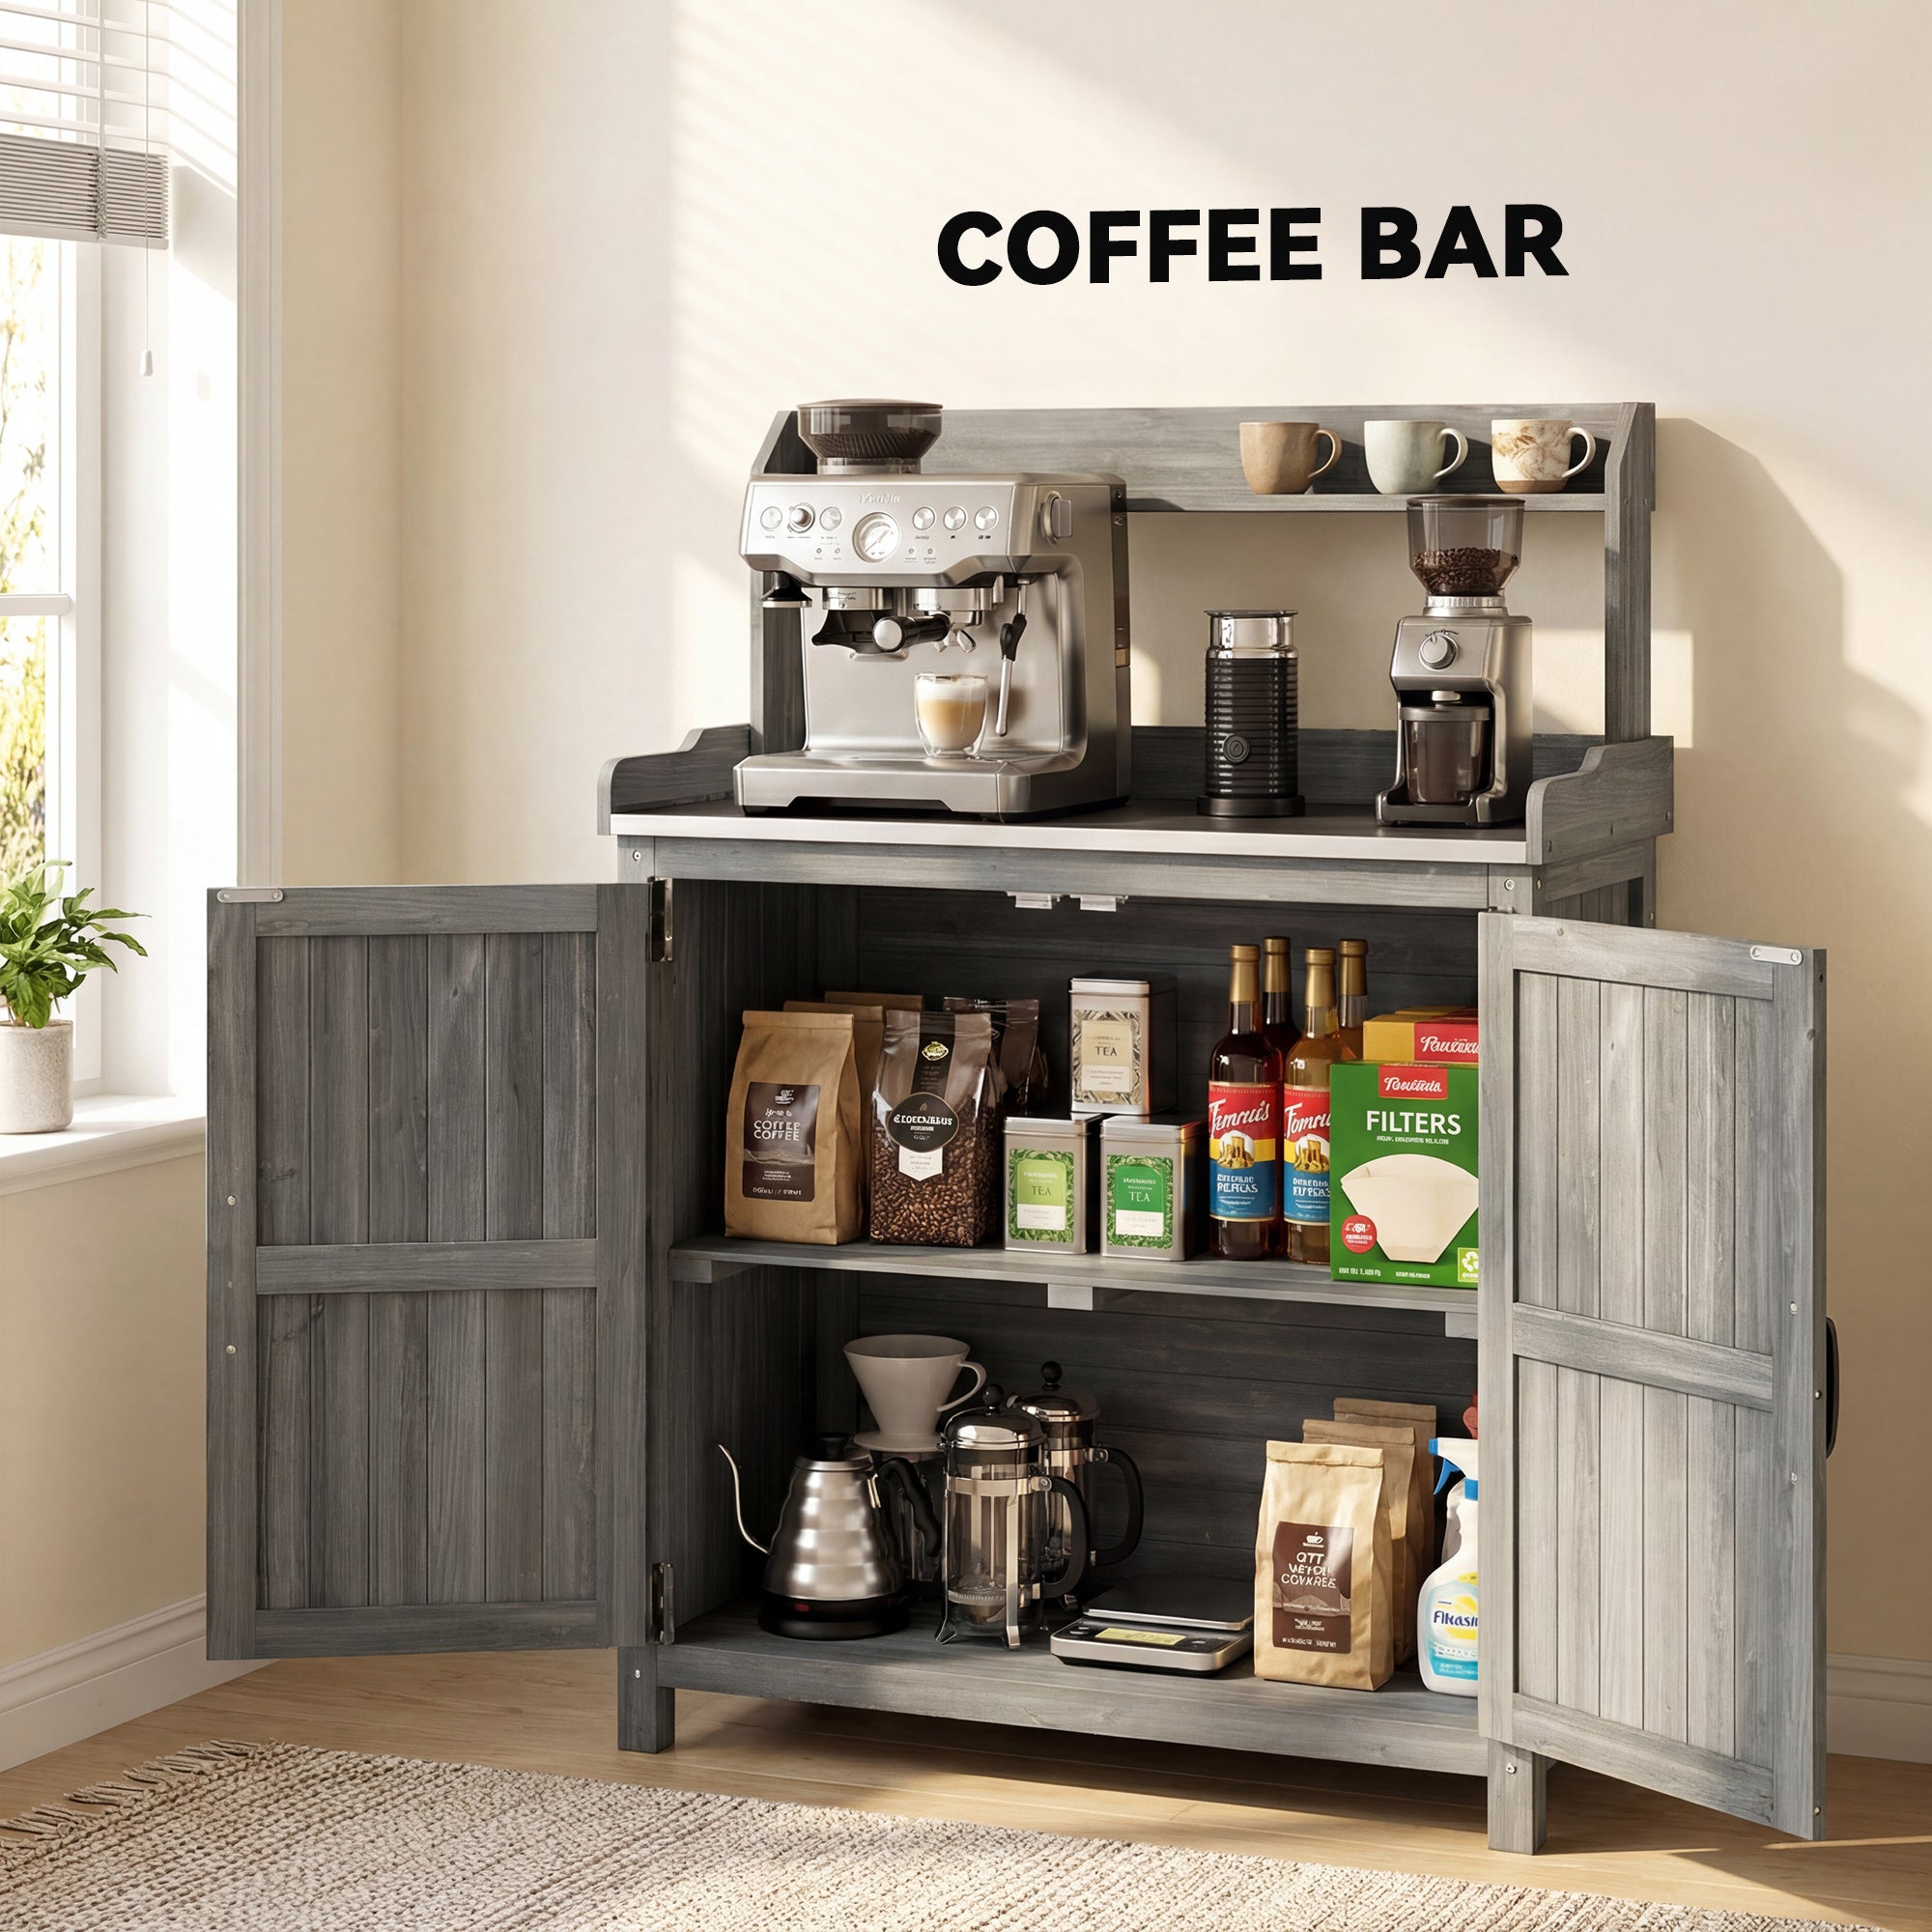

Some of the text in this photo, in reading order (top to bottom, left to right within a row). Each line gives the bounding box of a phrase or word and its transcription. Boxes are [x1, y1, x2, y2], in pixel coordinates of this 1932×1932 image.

[937, 203, 1570, 287] COFFEE BAR
[1094, 1045, 1118, 1058] TEA
[1366, 1110, 1462, 1136] FILTERS
[1031, 1185, 1052, 1197] TEA
[1128, 1191, 1151, 1203] TEA
